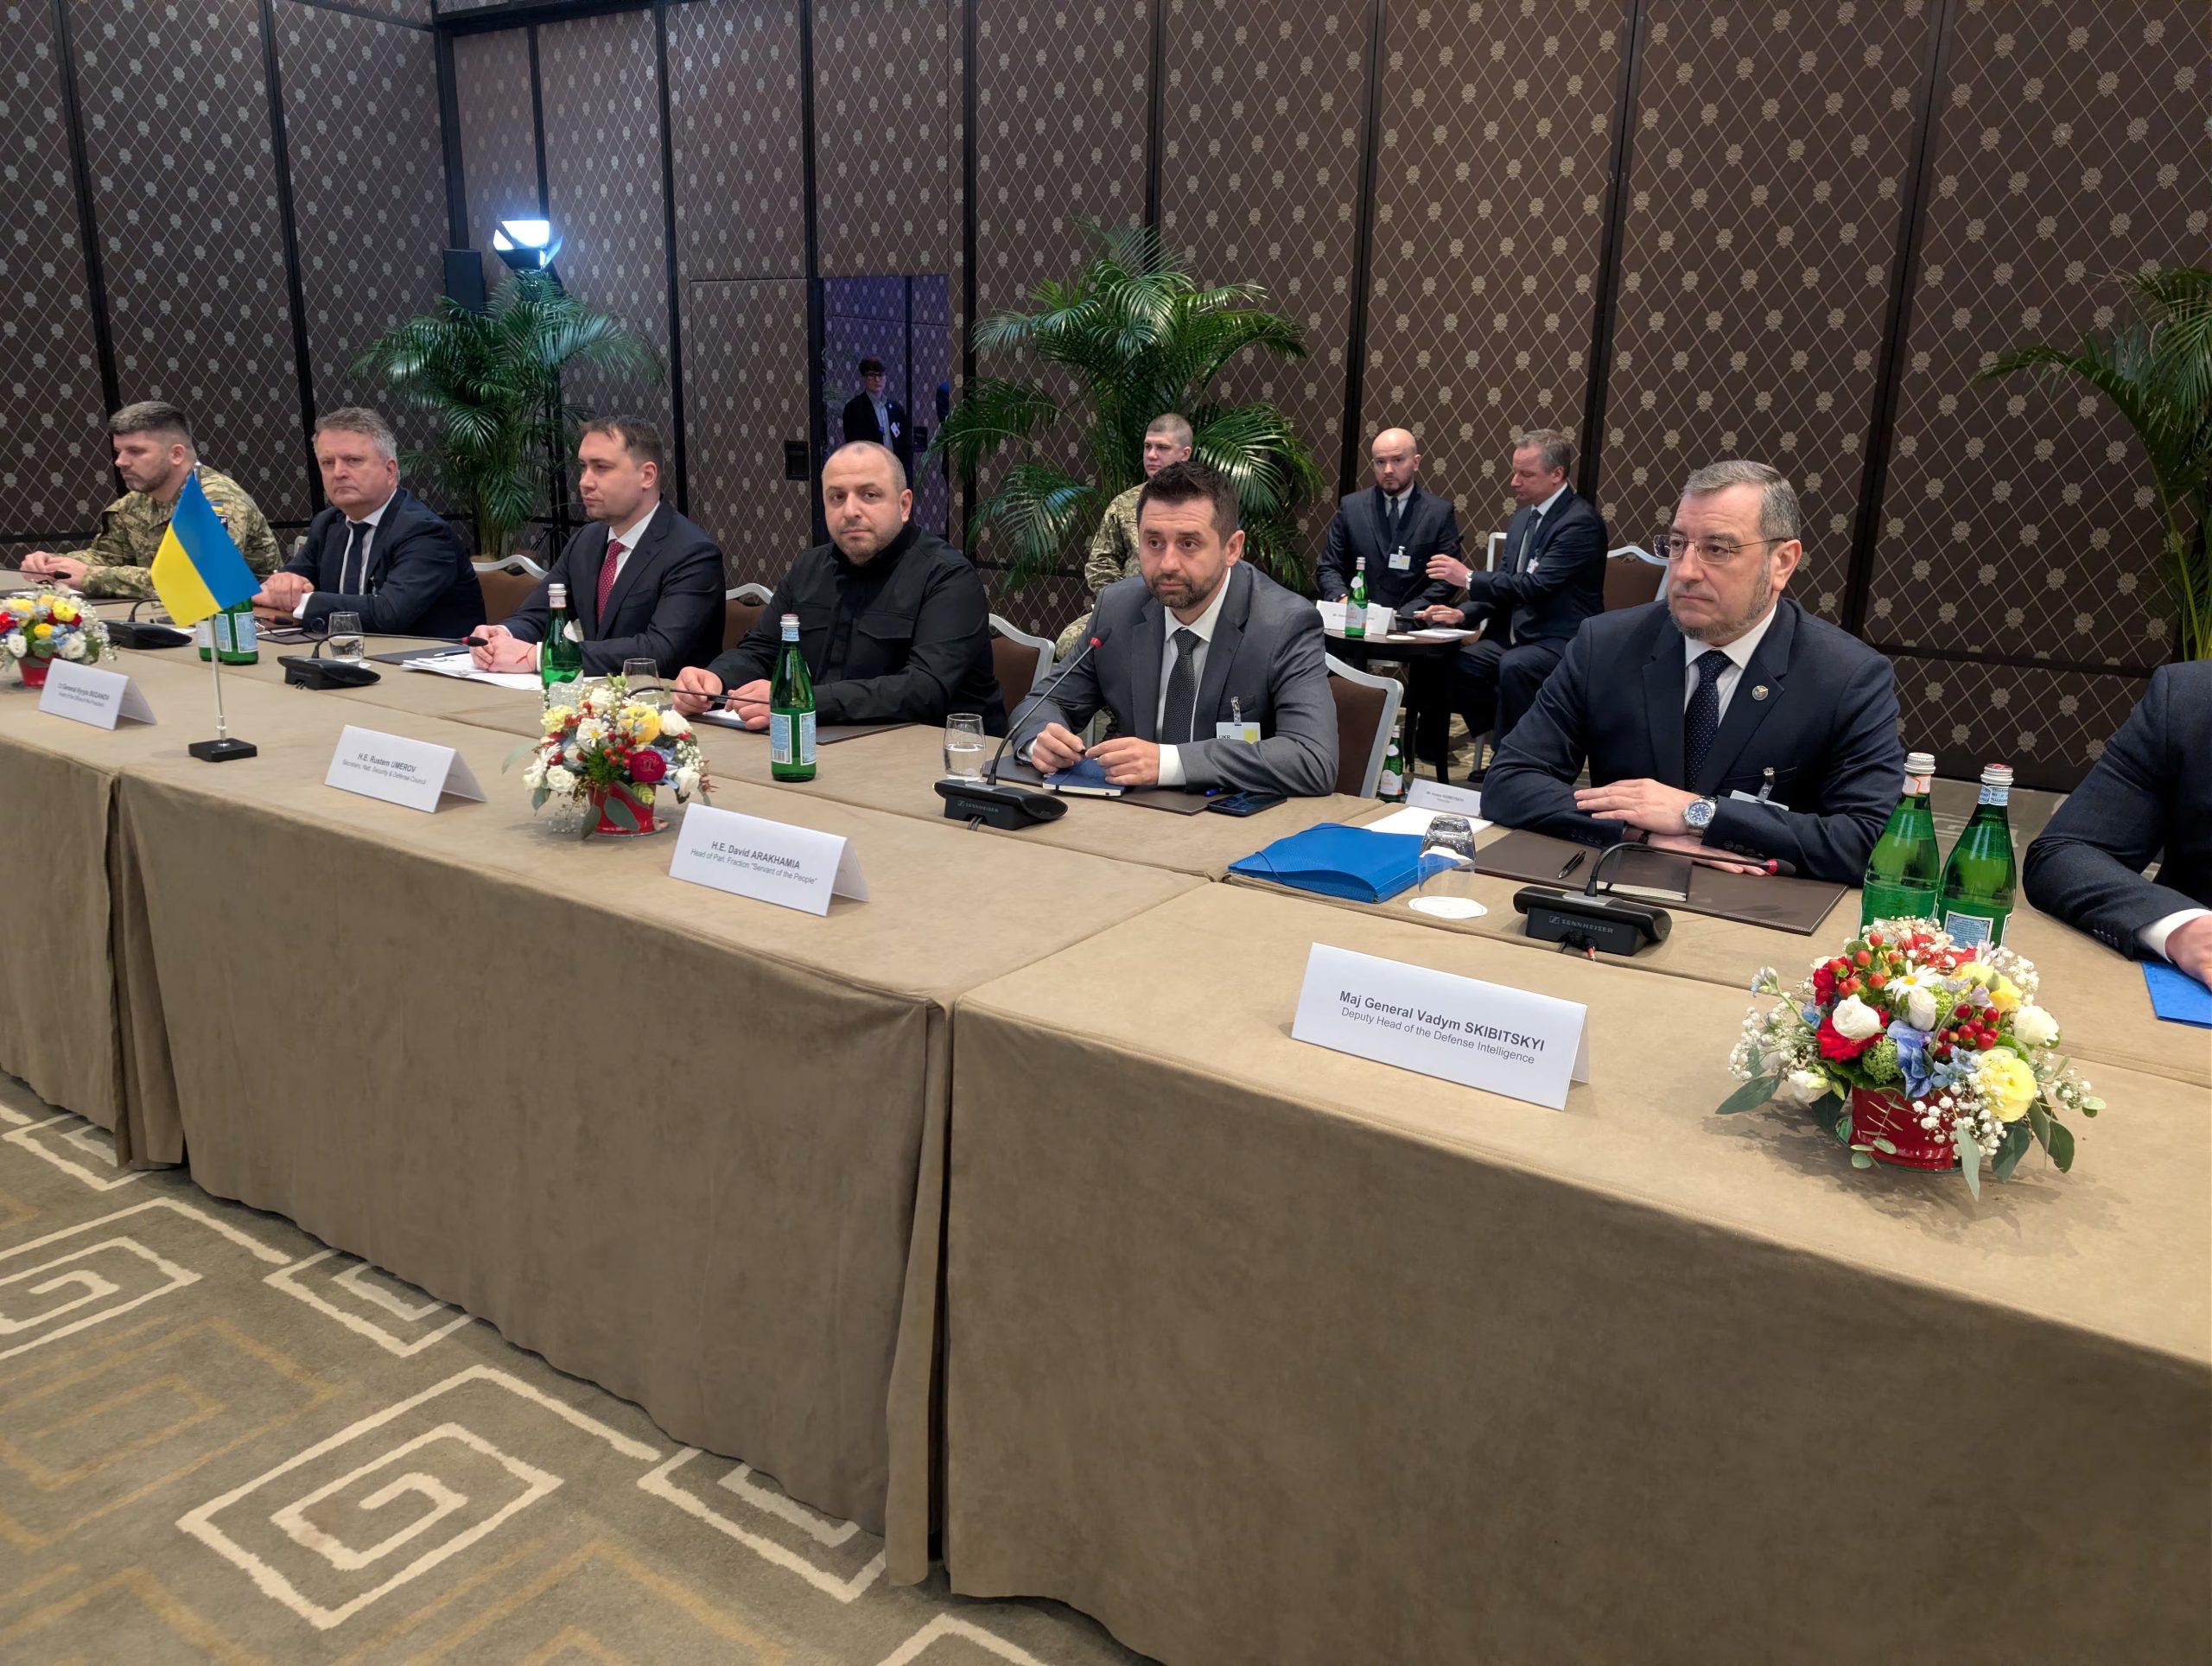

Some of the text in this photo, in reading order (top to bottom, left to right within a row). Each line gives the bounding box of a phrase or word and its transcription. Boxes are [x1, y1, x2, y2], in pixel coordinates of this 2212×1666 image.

[357, 753, 416, 773] H.E. Rustem UMEROV
[372, 766, 389, 777] Security
[393, 771, 410, 781] Defense
[410, 775, 427, 785] Council
[690, 848, 706, 858] Head
[727, 856, 750, 868] Fraction
[751, 862, 775, 876] "Servant
[775, 868, 783, 877] of
[783, 870, 793, 879] the
[793, 873, 817, 885] People"
[711, 841, 800, 869] H.E. David ARAKHAMIA
[1561, 919, 1614, 934] SENNHEISER
[1339, 990, 1546, 1052] Maj General Vadym SKIBITSKYI
[1341, 1007, 1535, 1065] Deputy Head of the Defense Intelligence
